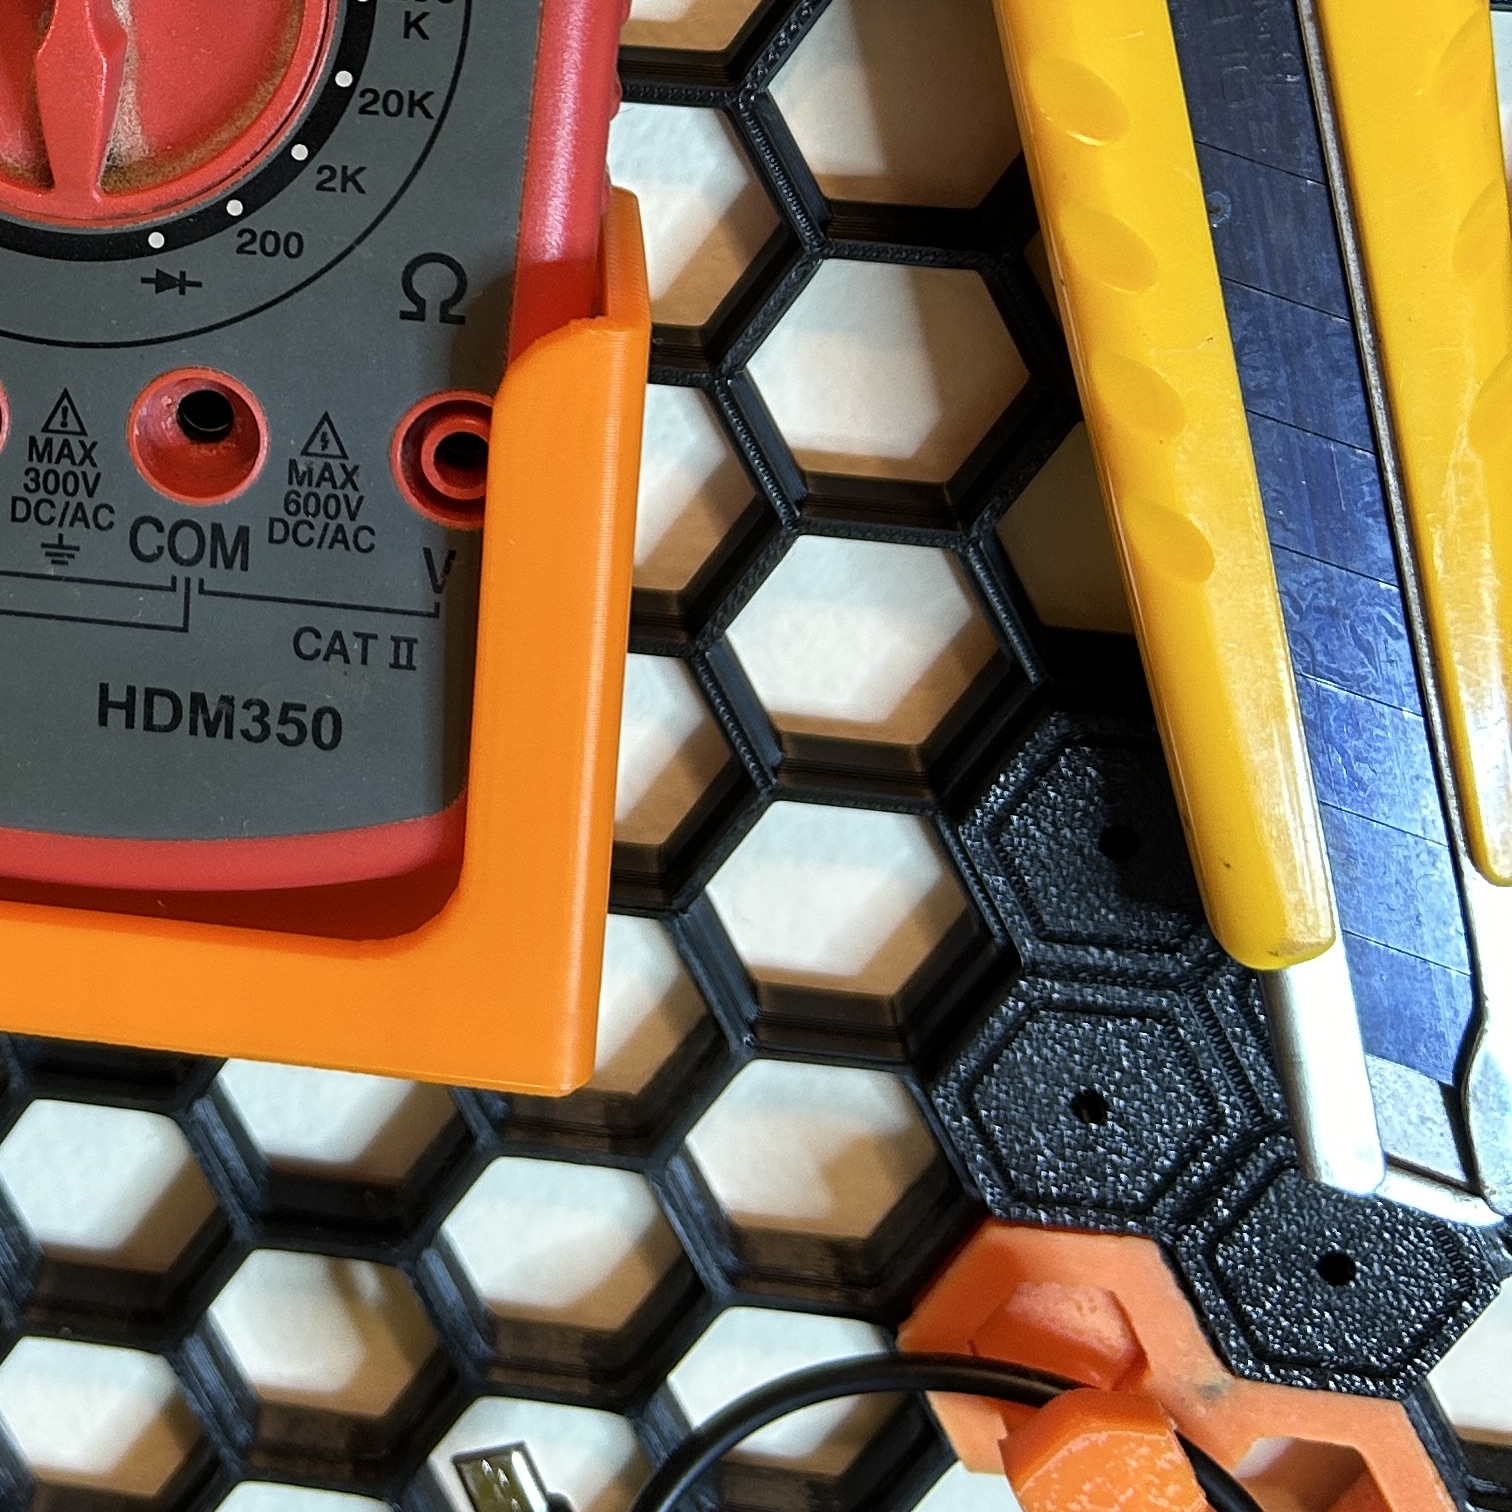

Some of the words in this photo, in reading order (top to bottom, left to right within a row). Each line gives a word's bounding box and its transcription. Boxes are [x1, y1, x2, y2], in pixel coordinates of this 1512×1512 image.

[403, 11, 430, 40] K
[358, 89, 435, 119] 20K
[315, 165, 366, 194] 2K
[236, 228, 304, 258] 200
[28, 436, 98, 468] MAX
[23, 467, 102, 498] 300V
[288, 458, 360, 492] MAX
[10, 496, 115, 532] DC/AC
[283, 489, 364, 522] 600V
[129, 516, 250, 572] COM
[268, 517, 376, 553] DC/AC
[423, 547, 456, 594] V
[292, 626, 378, 666] CAT
[97, 682, 343, 751] HDM350
